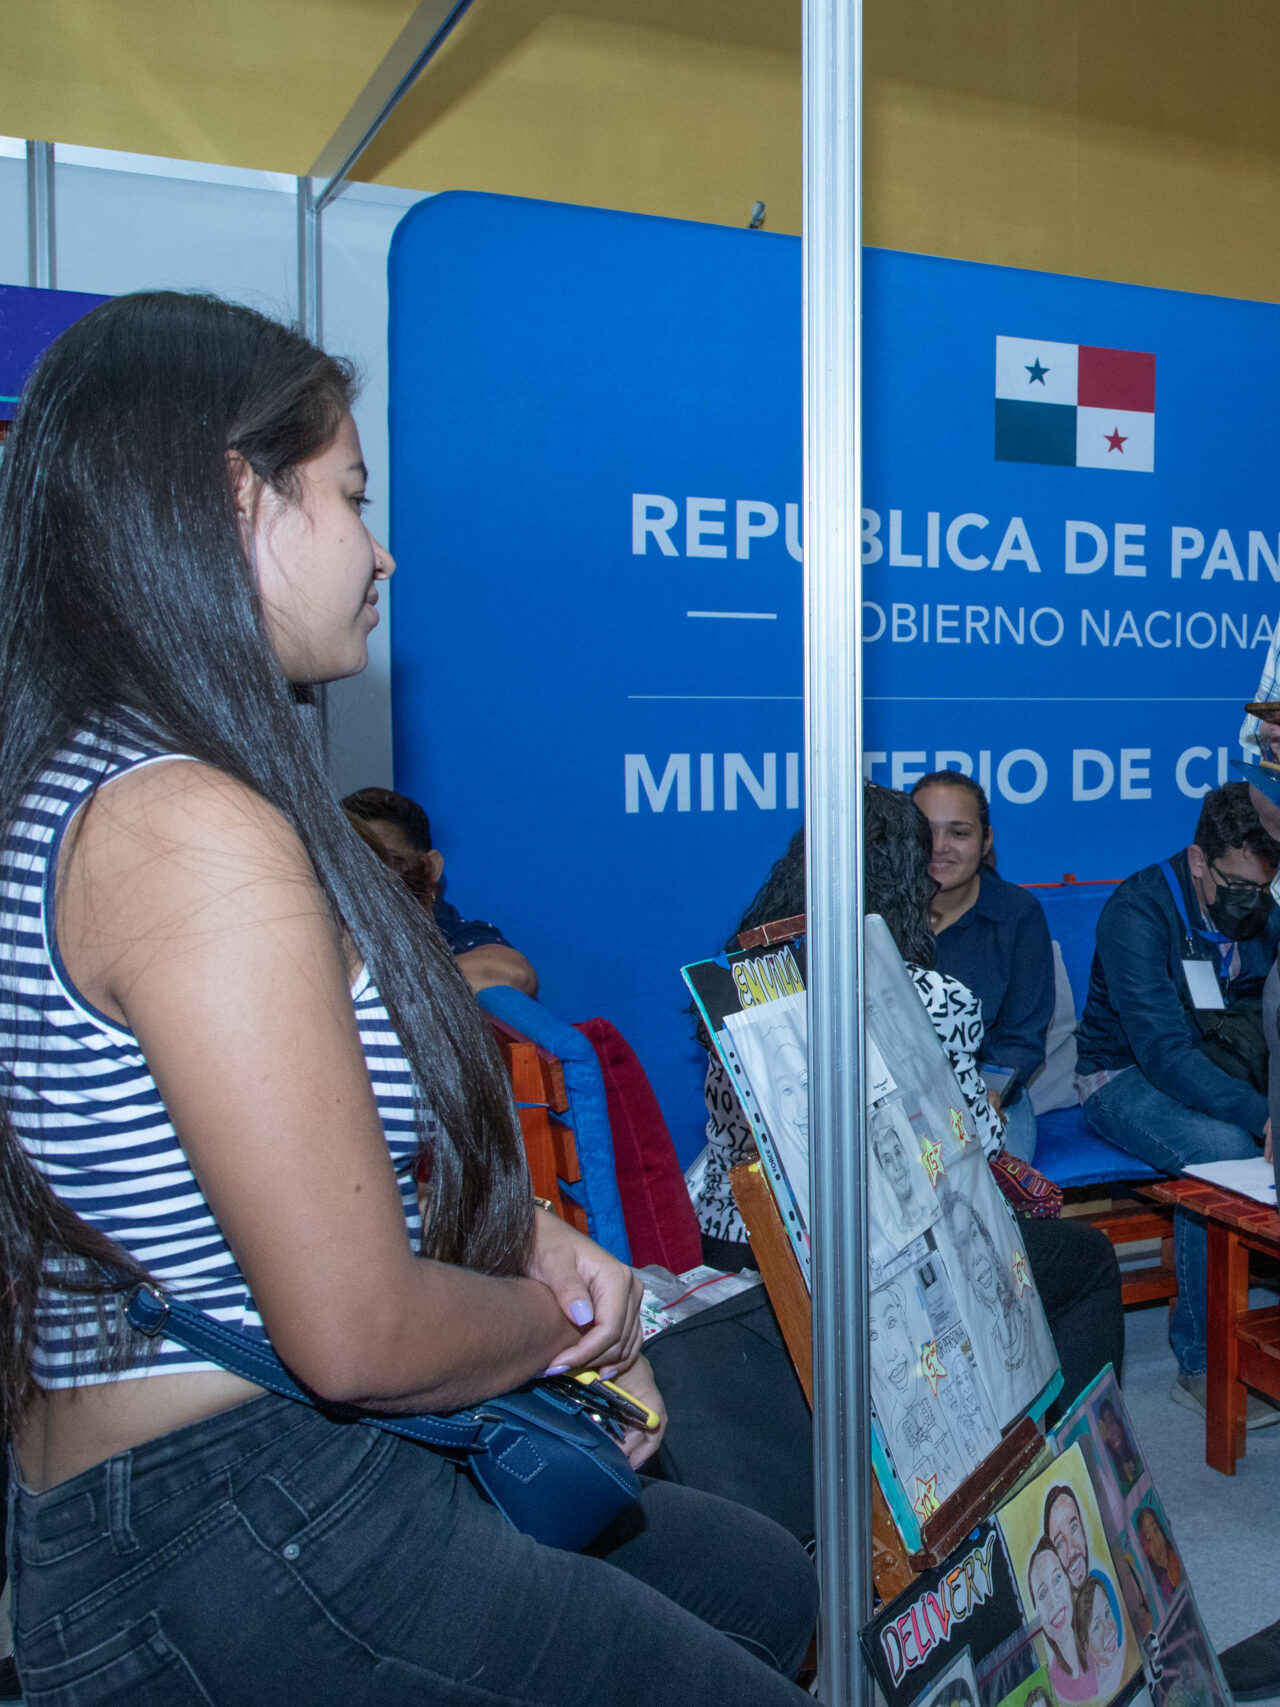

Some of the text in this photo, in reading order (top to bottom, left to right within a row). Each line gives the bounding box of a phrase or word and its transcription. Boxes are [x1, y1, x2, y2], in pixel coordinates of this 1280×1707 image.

[1065, 520, 1147, 577] DE
[861, 600, 1275, 649] OBIERNO NACIONA
[1072, 749, 1152, 801] DE
